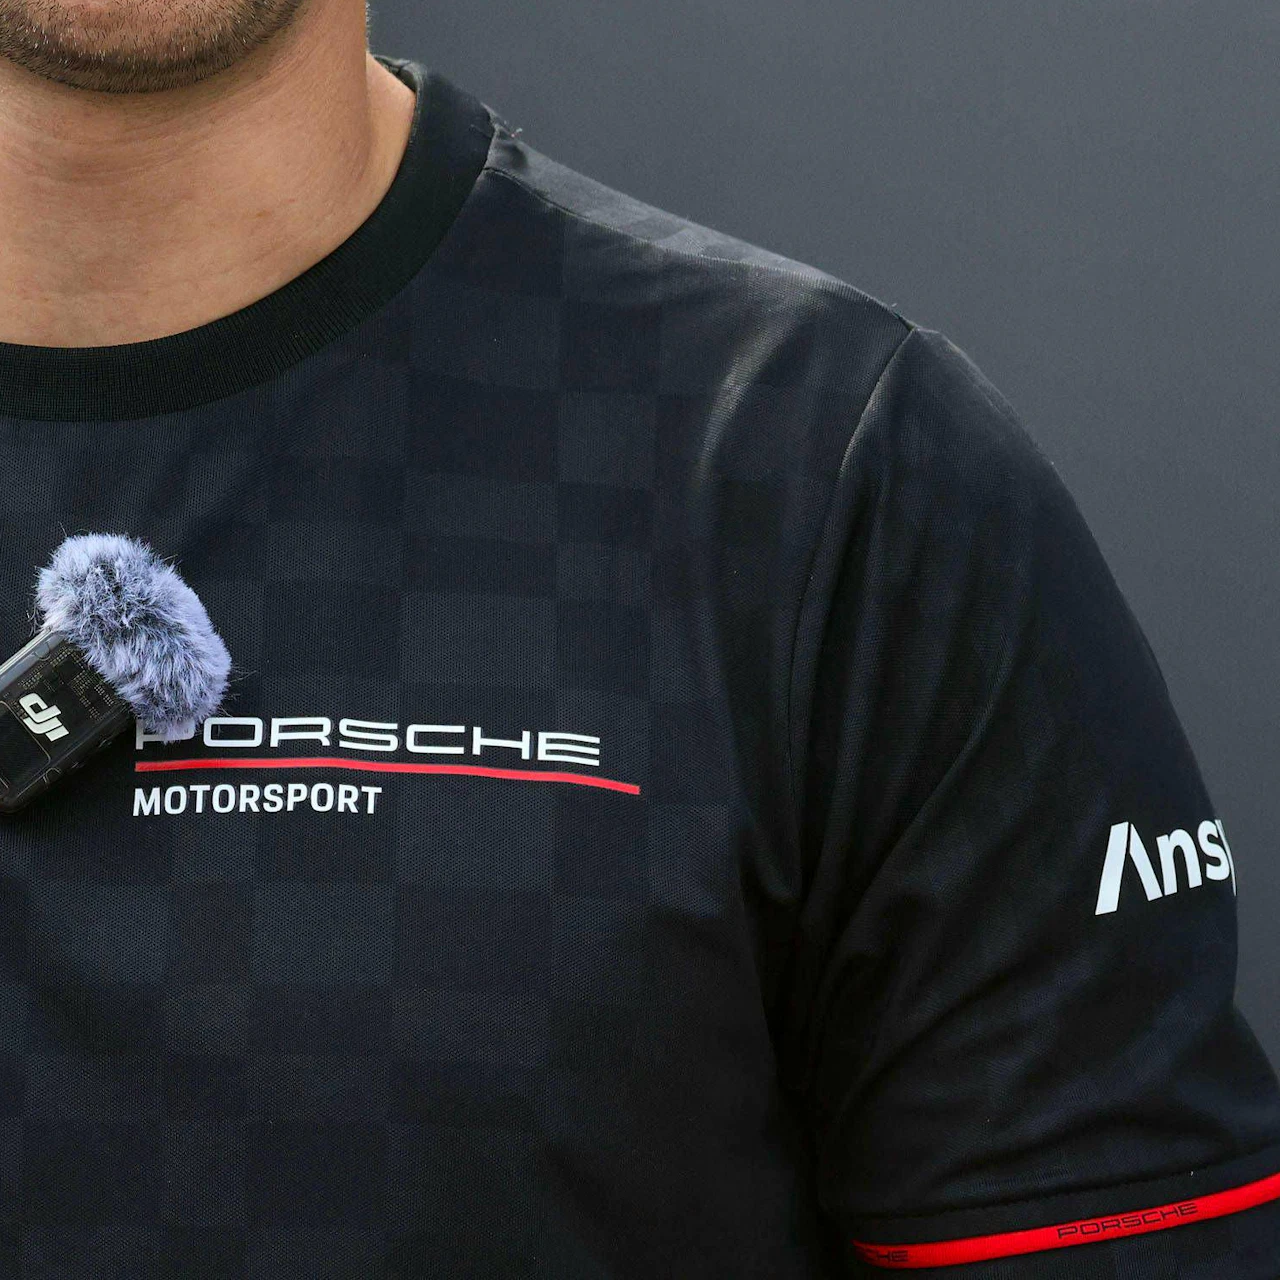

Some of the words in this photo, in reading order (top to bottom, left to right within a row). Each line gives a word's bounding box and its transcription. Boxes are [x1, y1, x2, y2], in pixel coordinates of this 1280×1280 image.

[132, 783, 383, 817] MOTORSPORT
[1094, 818, 1238, 916] Ans
[1057, 1202, 1199, 1239] PORSCHE
